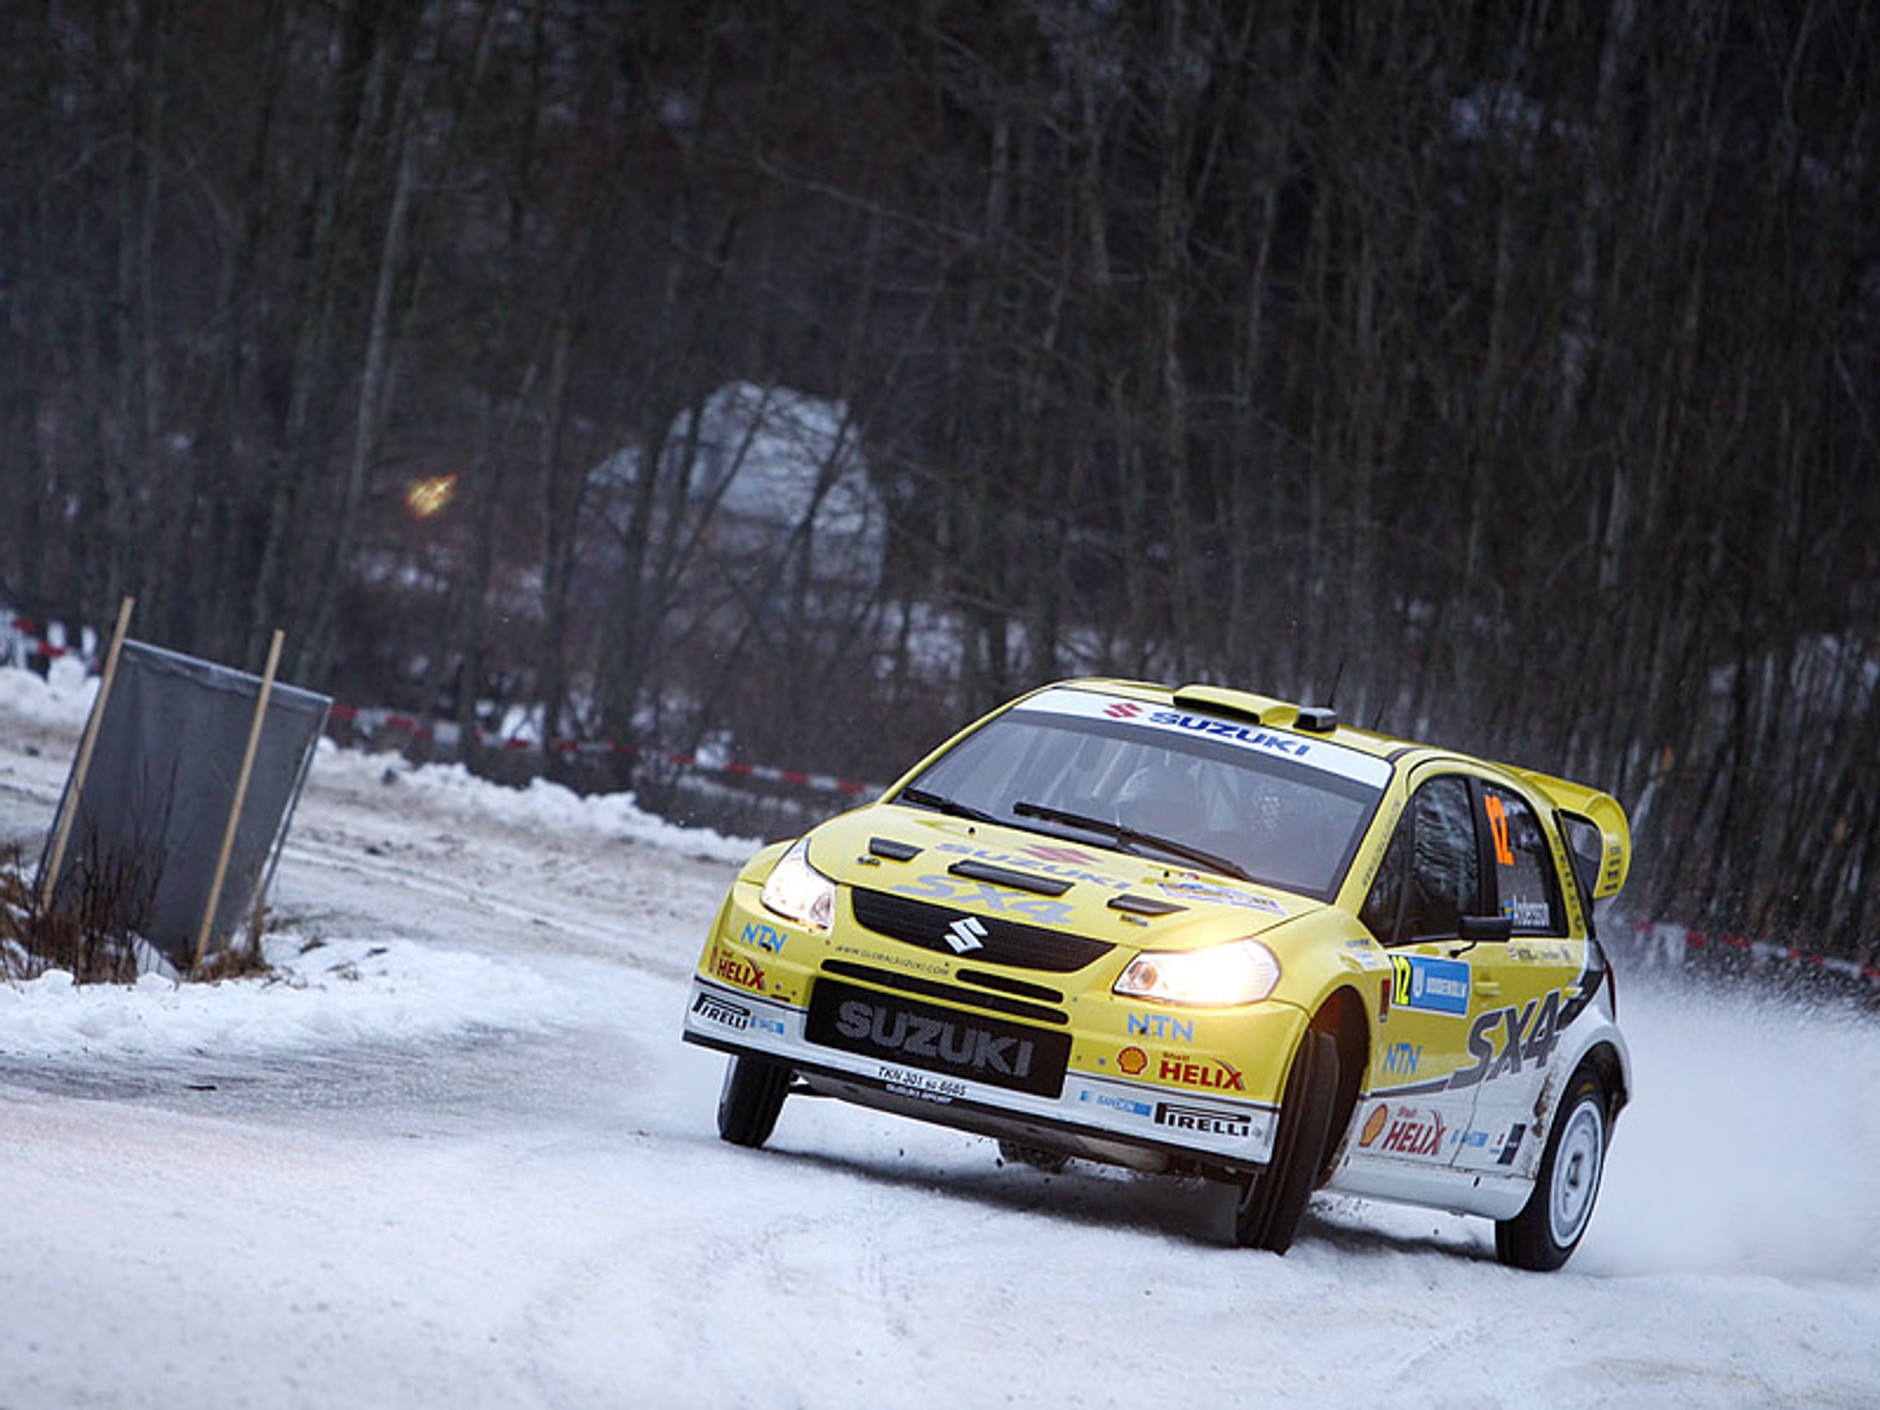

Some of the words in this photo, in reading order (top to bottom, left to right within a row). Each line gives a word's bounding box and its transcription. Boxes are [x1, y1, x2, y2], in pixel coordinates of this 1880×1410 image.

[1148, 711, 1311, 756] SUZUKI
[936, 843, 1132, 890] SUZUKI
[889, 873, 1078, 925] SX4
[741, 922, 788, 955] NTN
[717, 956, 766, 991] HELIX
[1391, 955, 1411, 1006] 12
[692, 992, 751, 1031] PIRELLI
[1128, 1013, 1194, 1043] NTN
[835, 1001, 1035, 1078] SUZUKI
[1450, 987, 1561, 1089] SX4
[1159, 1057, 1246, 1091] HELIX
[1383, 1042, 1422, 1076] NTN
[1154, 1102, 1252, 1137] PIRELLI
[1382, 1118, 1447, 1156] HELIX
